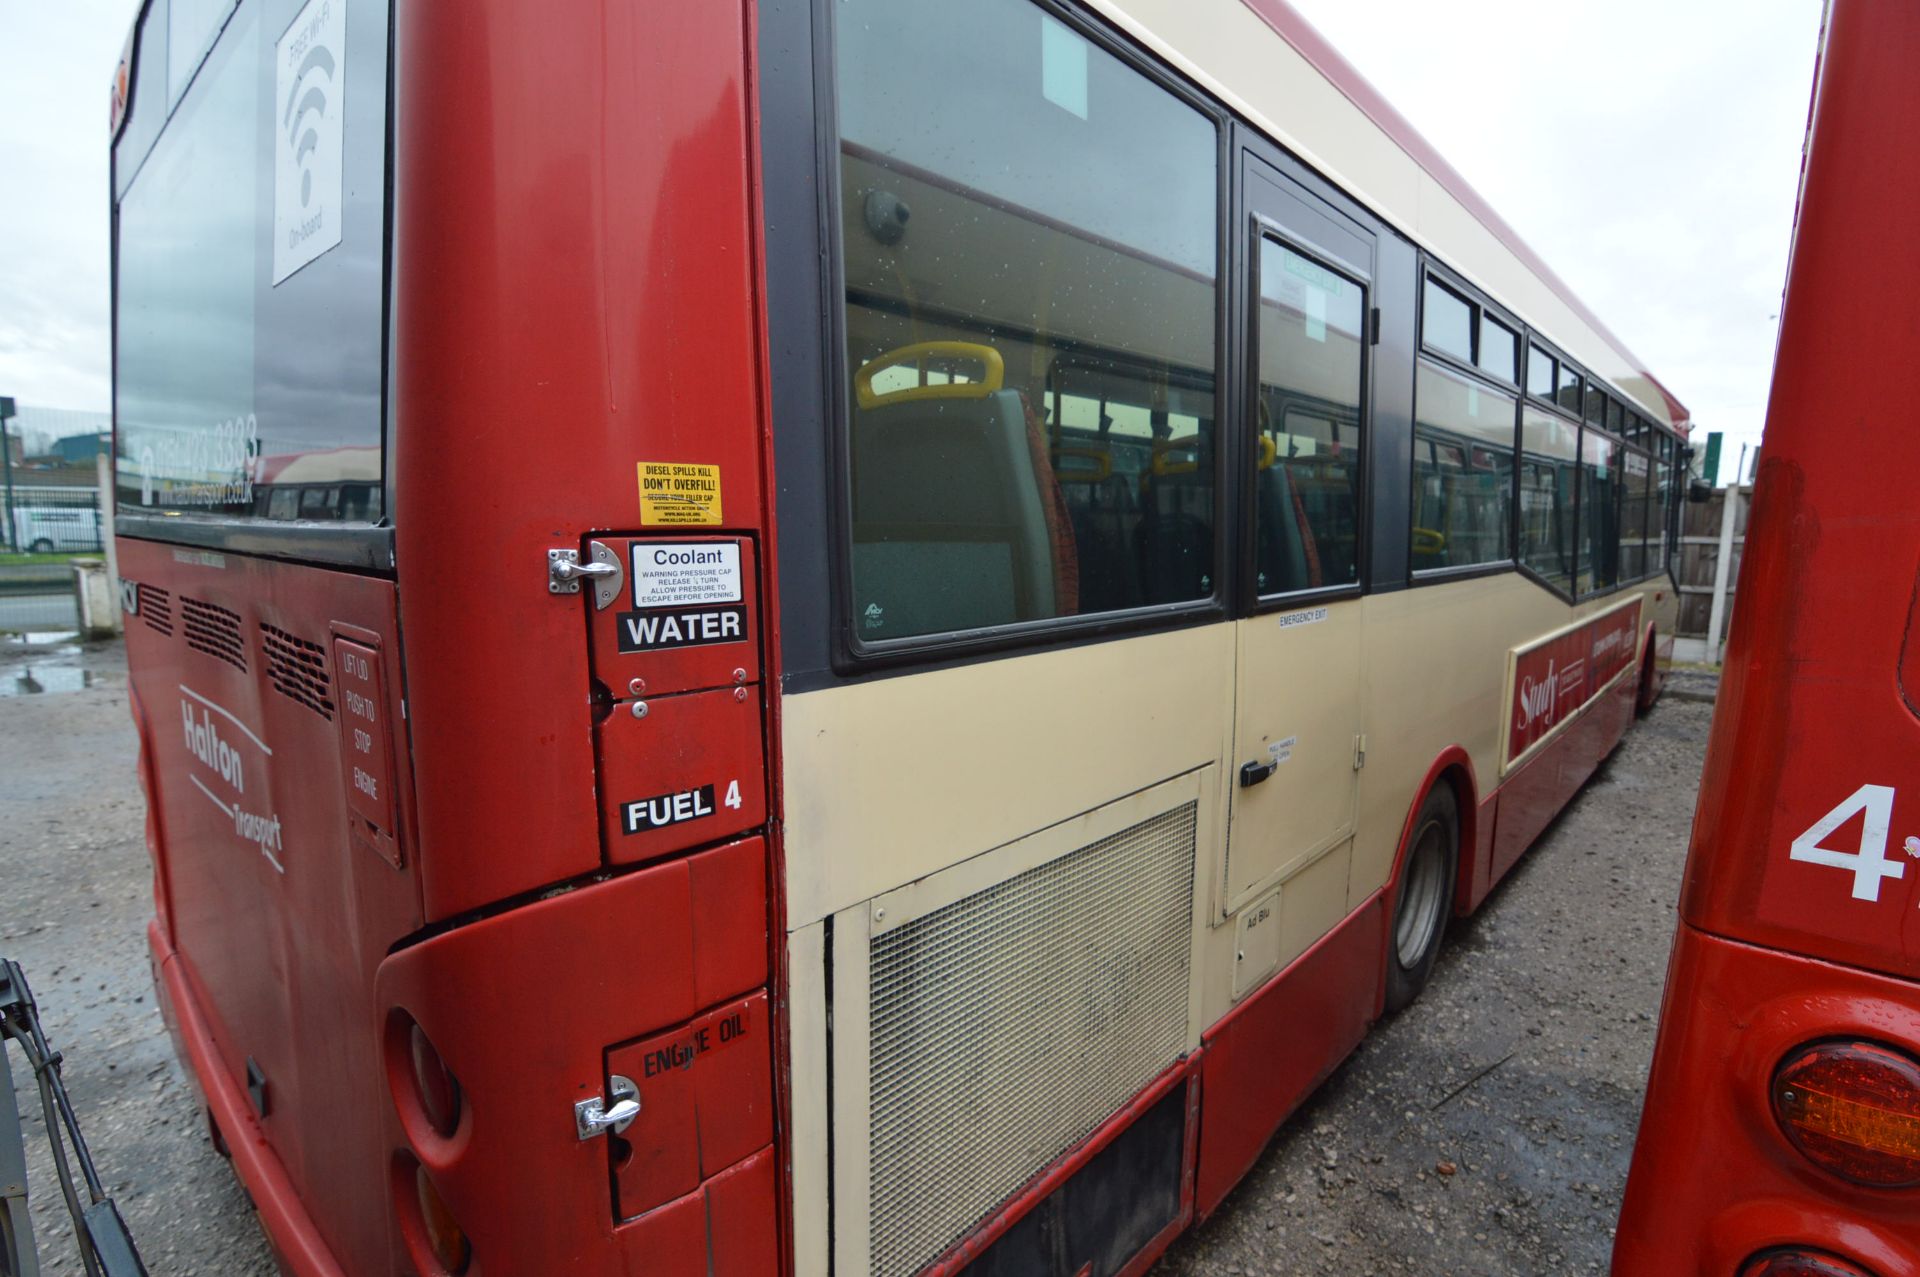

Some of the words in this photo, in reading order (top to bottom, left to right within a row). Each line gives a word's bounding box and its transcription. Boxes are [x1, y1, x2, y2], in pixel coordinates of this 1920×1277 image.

[215, 413, 257, 468] 3333
[644, 478, 671, 490] DON'T
[674, 479, 716, 491] OVERFILL!
[646, 465, 671, 476] DIESEL
[673, 466, 696, 477] SPILLS
[698, 467, 712, 477] KILL
[654, 549, 723, 565] Coolant
[658, 578, 690, 586] RELEASE
[680, 569, 716, 577] PRESSURE
[642, 595, 672, 603] ESCAPE
[674, 593, 702, 601] BEFORE
[627, 611, 740, 645] WATER
[343, 652, 356, 674] LIFT
[357, 659, 368, 681] LID
[347, 690, 363, 717] PUSH
[364, 698, 375, 722] TO
[181, 699, 243, 793] Halton
[354, 728, 372, 753] STOP
[354, 766, 378, 800] ENGINE
[628, 790, 711, 831] FUEL
[724, 780, 742, 810] 4
[233, 803, 282, 856] Transport
[1247, 914, 1256, 931] Ad
[720, 1012, 746, 1042] OIL
